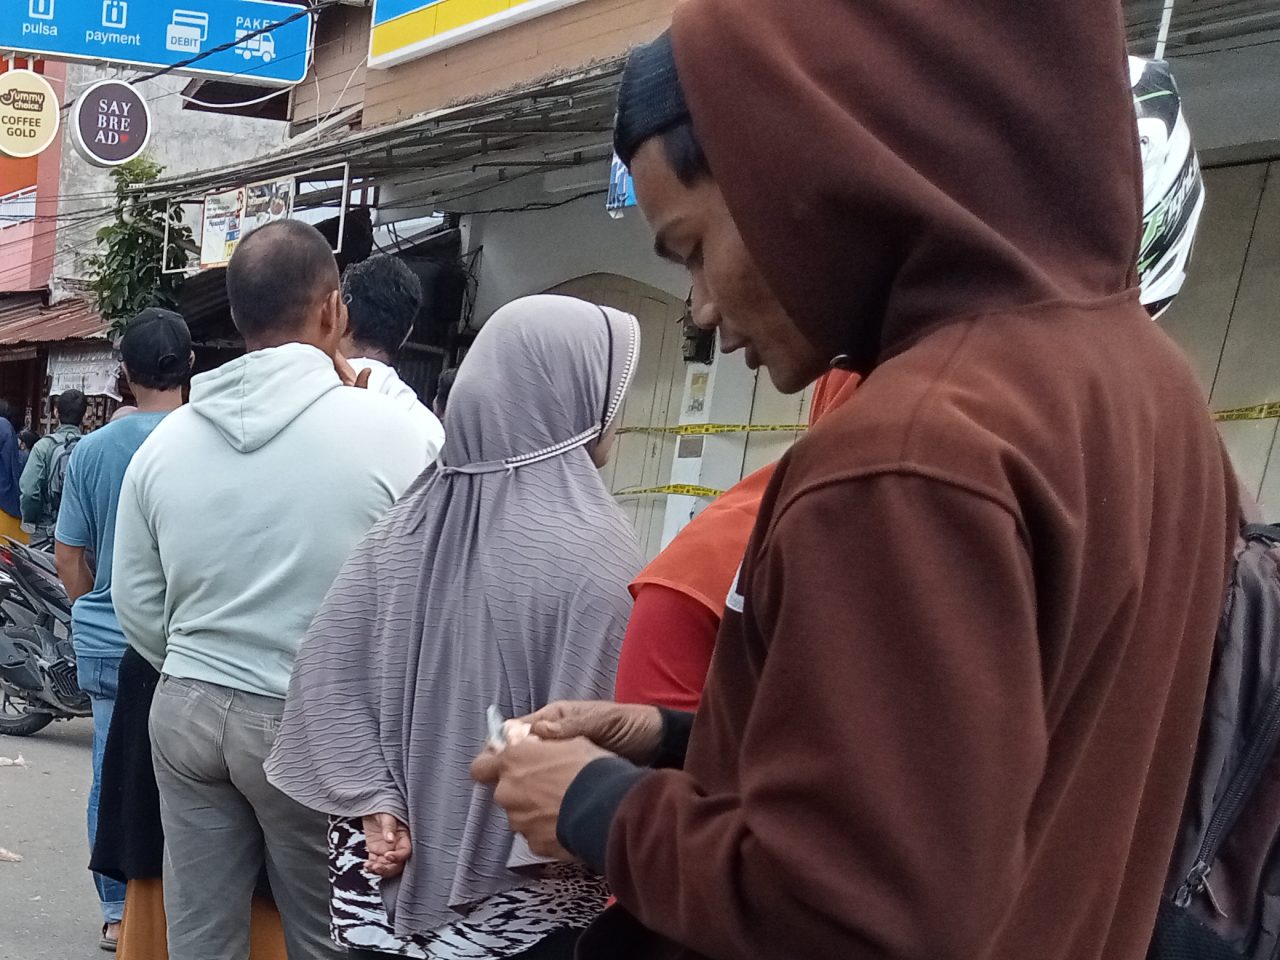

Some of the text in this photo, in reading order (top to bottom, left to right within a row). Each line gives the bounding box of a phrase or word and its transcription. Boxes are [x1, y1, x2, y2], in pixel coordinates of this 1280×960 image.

[22, 22, 58, 36] pulsa
[85, 30, 141, 46] payment
[170, 36, 199, 48] DEBIT
[0, 89, 45, 105] Yummy
[98, 98, 132, 116] SAY
[1, 115, 41, 127] COFFEE
[97, 113, 131, 132] BRE
[6, 127, 37, 138] GOLD
[94, 129, 119, 145] AD
